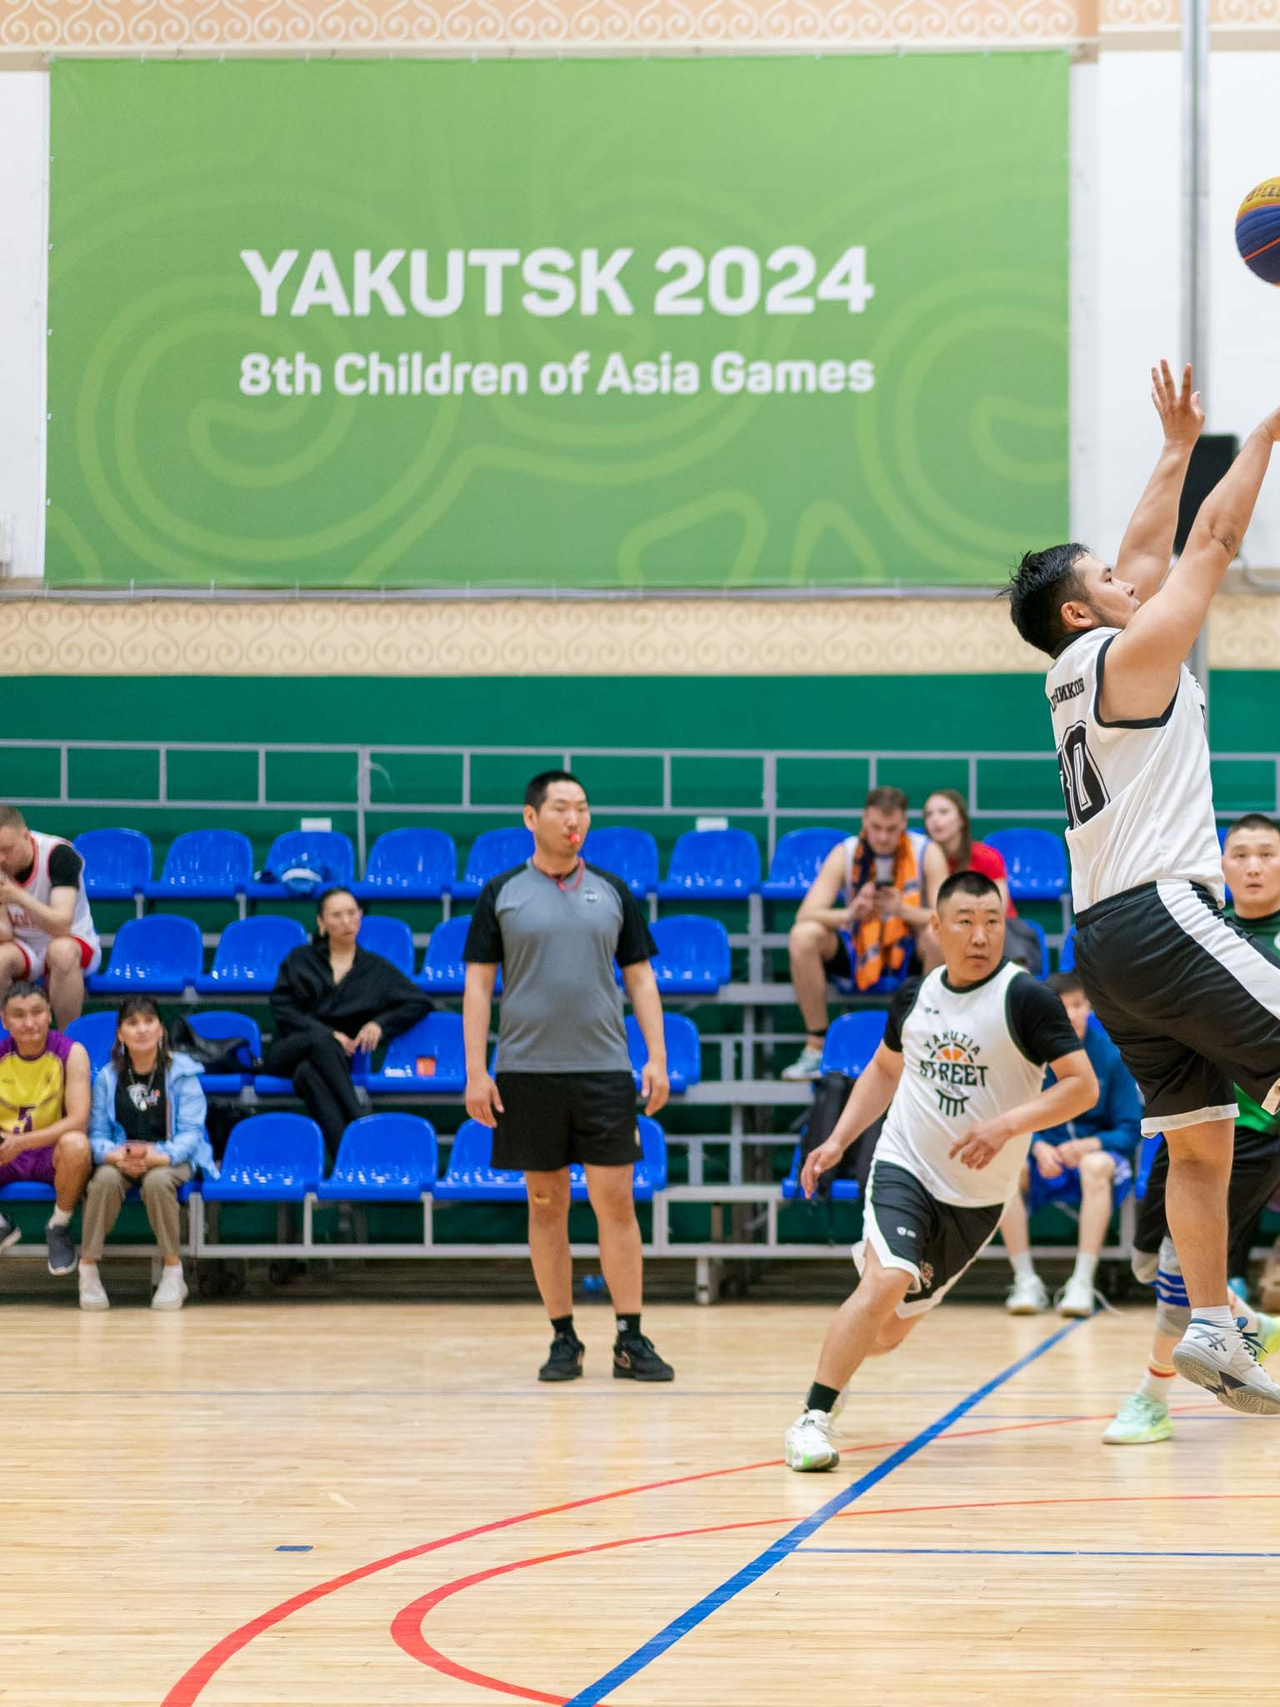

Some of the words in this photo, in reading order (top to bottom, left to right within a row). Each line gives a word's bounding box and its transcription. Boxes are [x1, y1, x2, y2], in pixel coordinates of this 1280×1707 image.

[240, 247, 635, 317] YAKUTSK
[653, 245, 875, 316] 2024
[239, 351, 321, 396] 8th
[333, 351, 528, 396] Children
[540, 351, 590, 395] of
[596, 351, 700, 394] Asia
[711, 350, 875, 394] Games
[924, 1030, 980, 1056] YAKUTIA
[920, 1060, 988, 1087] STREET
